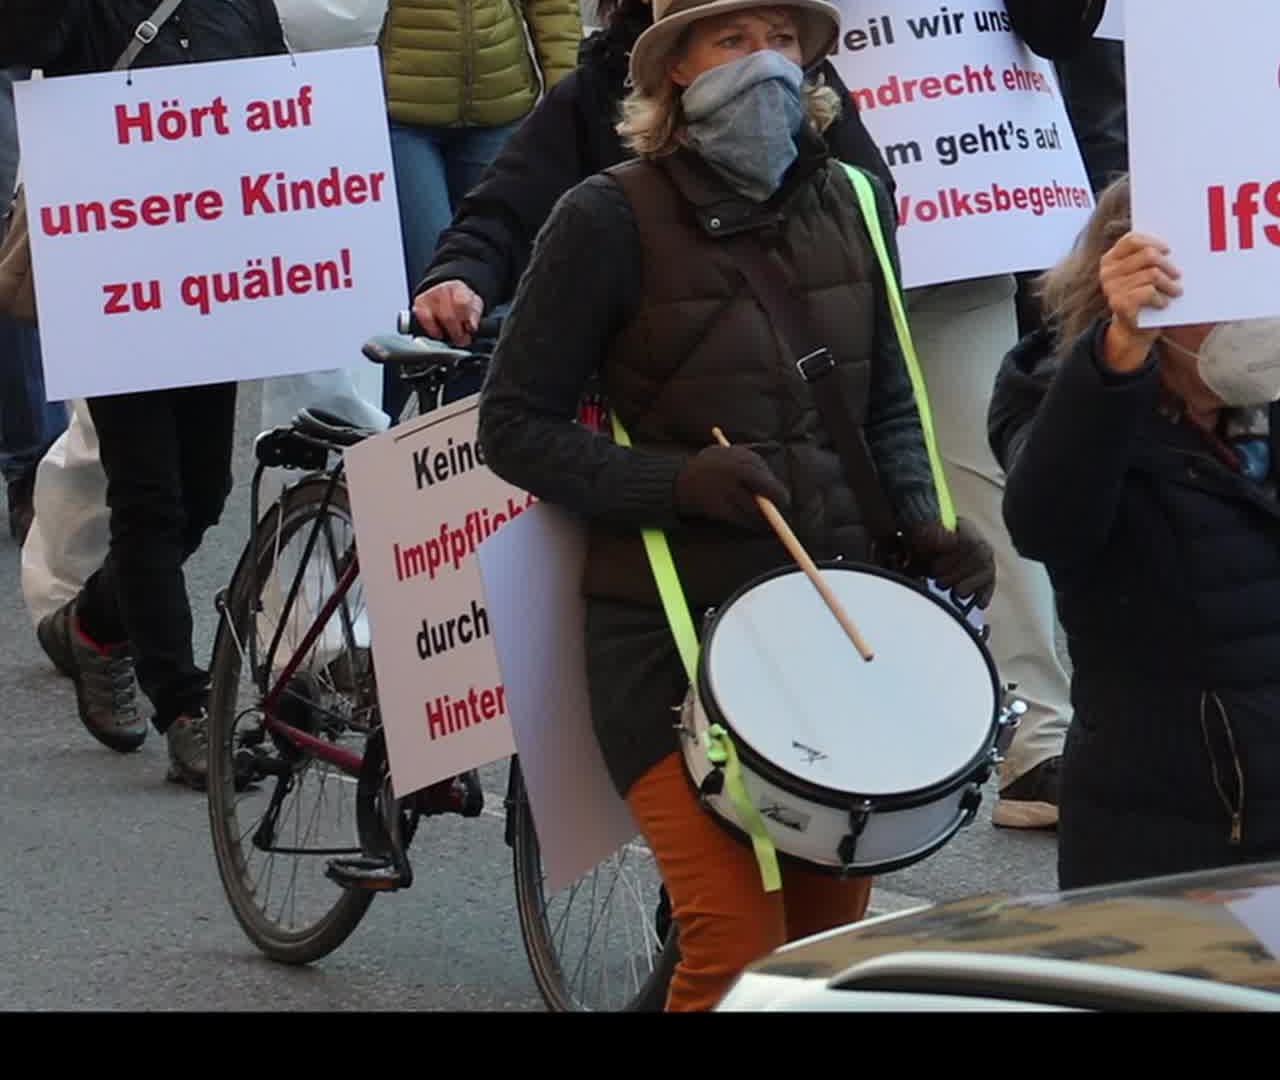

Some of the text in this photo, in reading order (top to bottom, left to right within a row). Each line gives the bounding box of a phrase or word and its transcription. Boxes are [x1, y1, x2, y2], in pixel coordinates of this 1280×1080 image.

[907, 6, 965, 40] wir
[113, 85, 314, 146] Hört auf
[39, 165, 386, 237] unsere Kinder
[102, 248, 355, 315] zu quälen!
[416, 599, 490, 661] durch
[425, 683, 506, 742] Hinter
